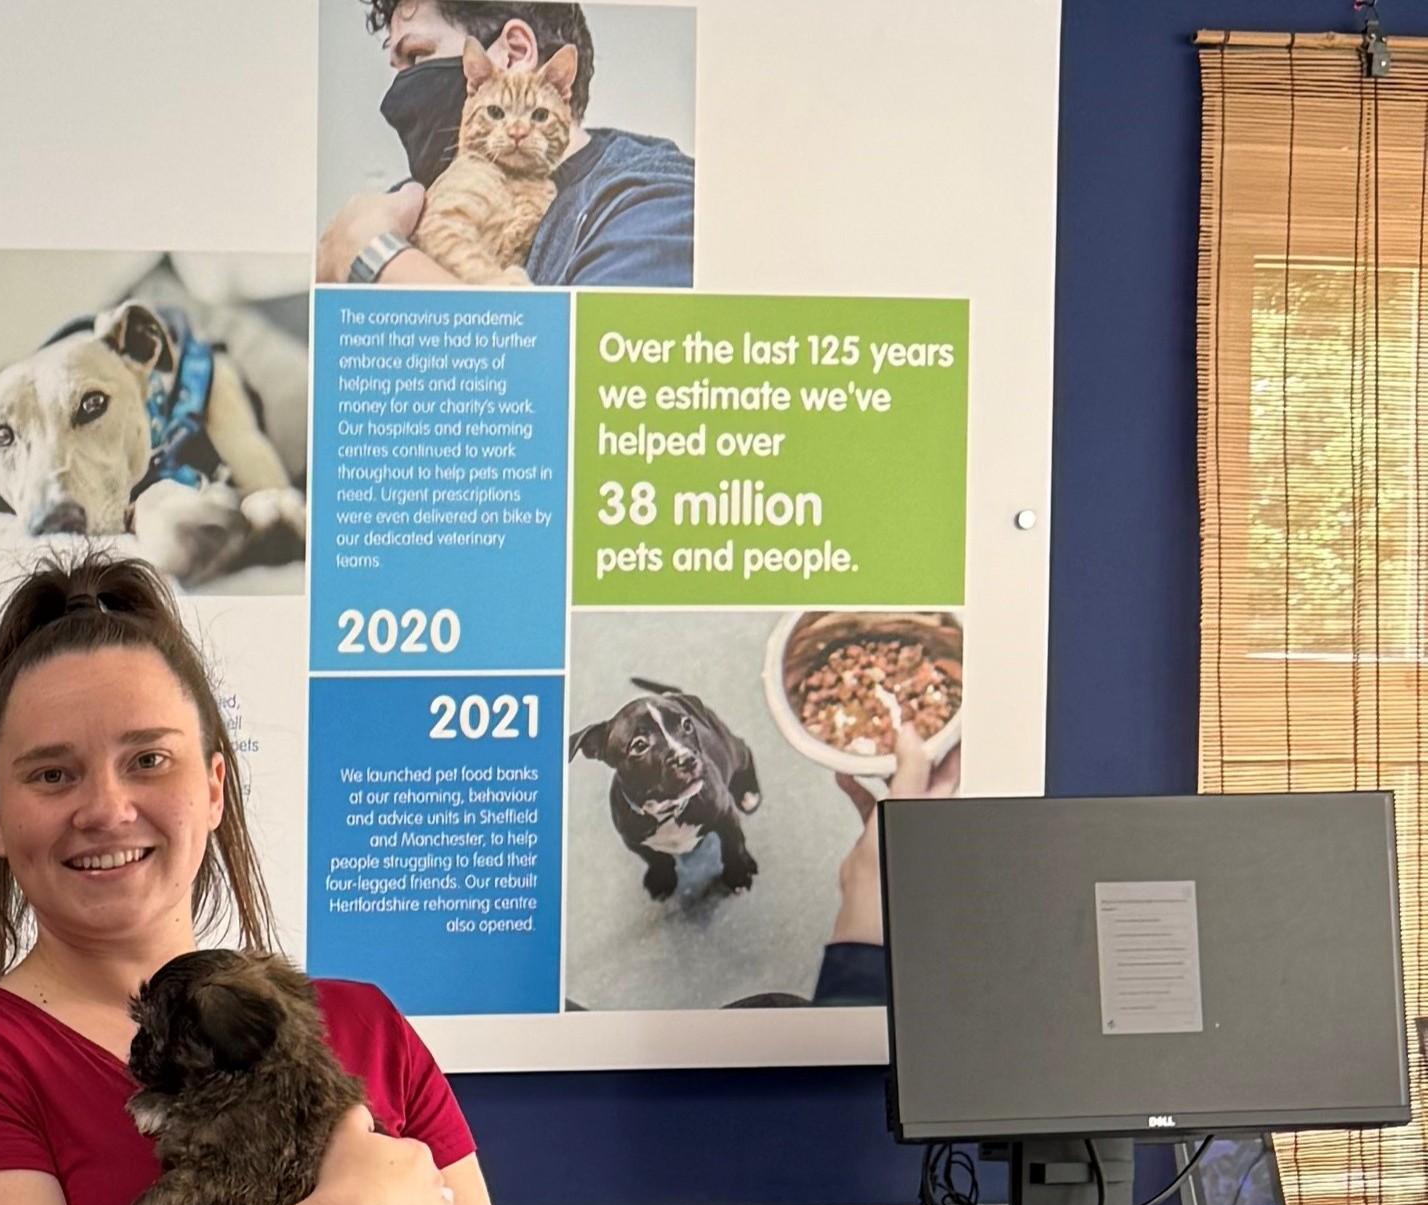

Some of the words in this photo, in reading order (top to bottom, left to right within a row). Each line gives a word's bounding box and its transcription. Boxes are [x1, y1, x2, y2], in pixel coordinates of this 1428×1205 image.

[342, 309, 364, 324] The
[368, 312, 450, 325] coronavirus
[454, 310, 523, 328] pandemic
[340, 333, 384, 346] meant
[389, 332, 414, 346] that
[419, 336, 440, 347] we
[444, 332, 471, 347] had
[476, 334, 488, 347] to
[492, 332, 536, 348] further
[340, 354, 402, 368] embrace
[406, 354, 448, 372] digital
[452, 358, 488, 372] ways
[492, 353, 505, 369] of
[600, 332, 675, 363] Over
[682, 332, 734, 364] the
[744, 333, 799, 364] last
[808, 335, 860, 366] 125
[870, 343, 954, 374] years
[339, 376, 391, 394] helping
[396, 378, 424, 394] pets
[428, 376, 456, 391] and
[460, 378, 506, 395] raising
[599, 386, 647, 409] we
[656, 378, 791, 410] estimate
[800, 382, 891, 412] we've
[599, 423, 706, 464] helped
[716, 433, 785, 456] over
[598, 481, 657, 525] 38
[674, 480, 822, 526] million
[597, 542, 663, 579] pets
[673, 540, 733, 571] and
[744, 540, 858, 579] people.
[337, 608, 461, 654] 2020
[429, 694, 538, 739] 2021
[341, 769, 362, 782] We
[367, 768, 431, 782] launched
[436, 768, 457, 784] pet
[462, 766, 492, 781] food
[497, 767, 538, 780] banks
[349, 791, 362, 804] at
[366, 792, 389, 804] our
[394, 790, 464, 806] rehoming,
[469, 788, 538, 802] behaviour
[347, 811, 374, 826] and
[378, 810, 423, 825] advice
[428, 811, 459, 824] units
[464, 811, 476, 824] in
[480, 808, 537, 824] Sheffield
[370, 832, 397, 847] and
[401, 832, 485, 846] Manchester,
[491, 832, 503, 845] to
[508, 832, 537, 848] help
[1148, 1115, 1176, 1128] DELL
